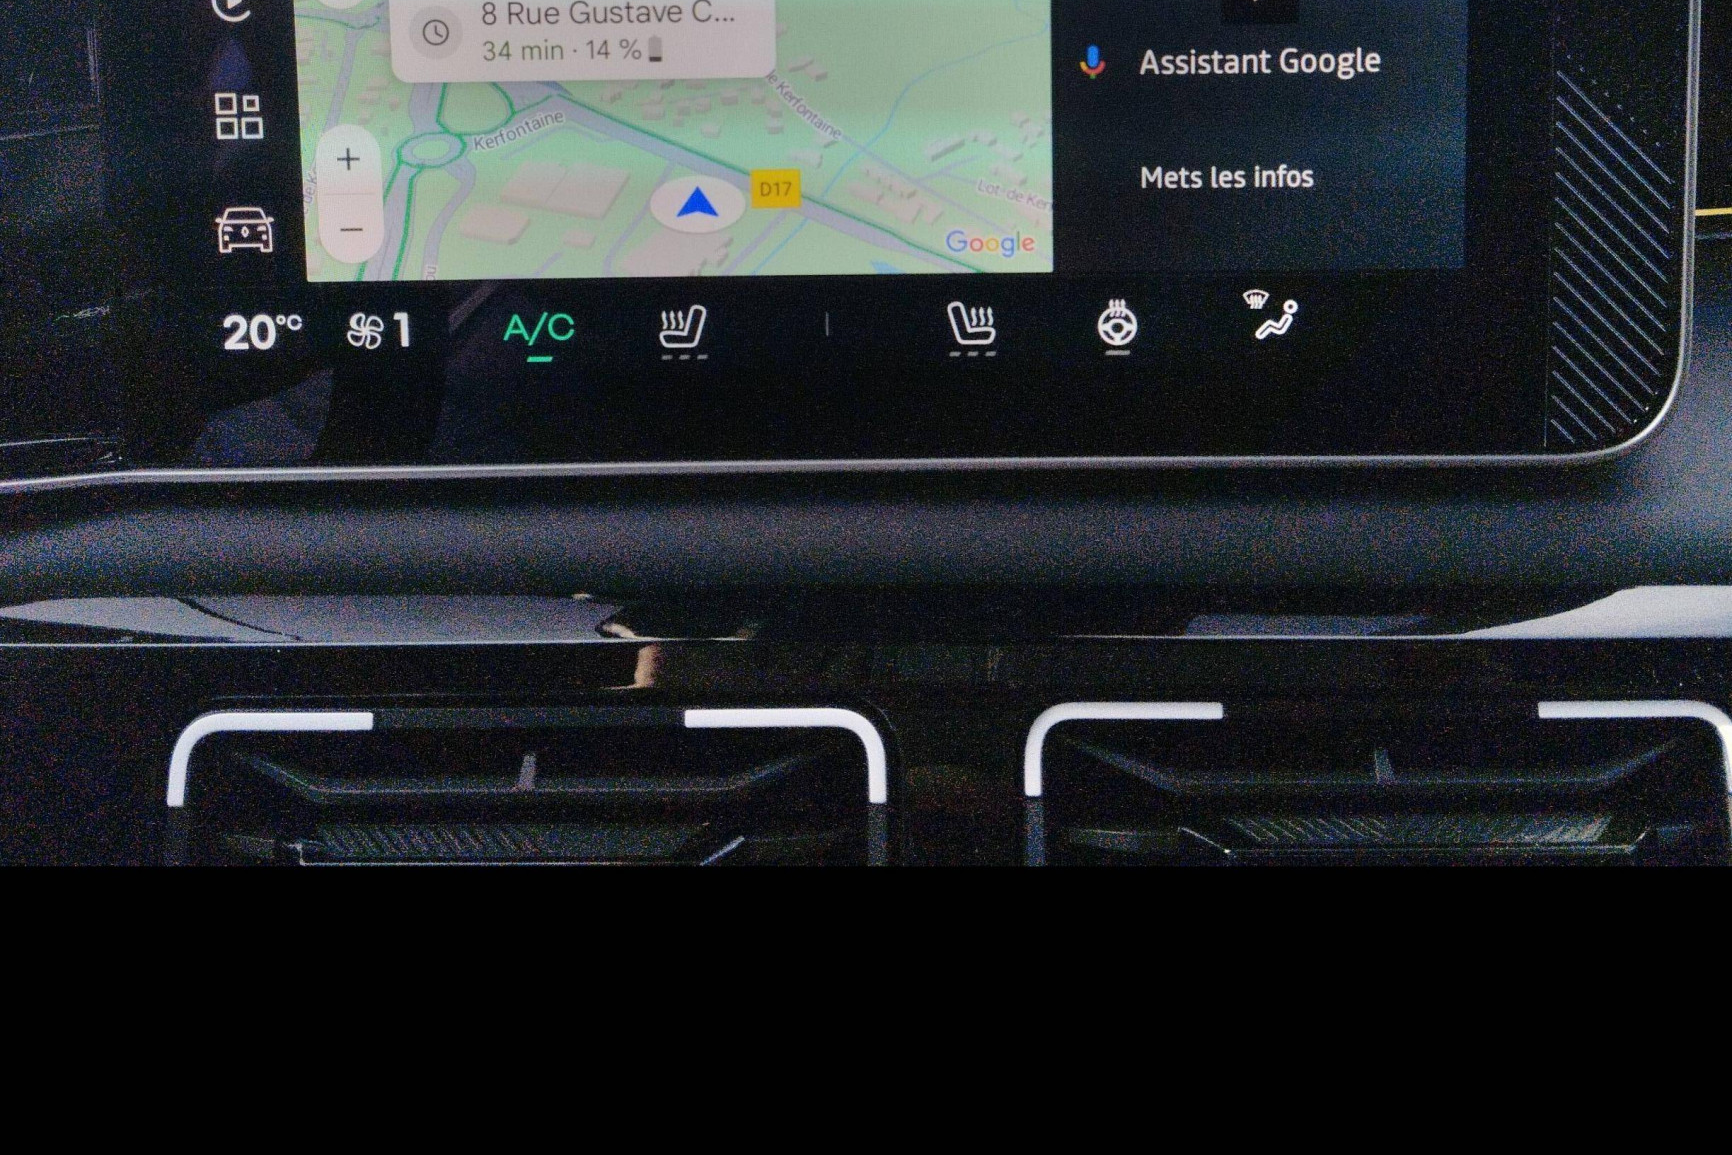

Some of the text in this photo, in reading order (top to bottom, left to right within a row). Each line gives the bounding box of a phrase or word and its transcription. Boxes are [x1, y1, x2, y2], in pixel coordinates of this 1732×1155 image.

[481, 0, 498, 26] 8
[507, 1, 561, 25] Rue
[568, 0, 683, 25] Gustave
[482, 38, 642, 62] 34 min 14 %
[1139, 46, 1382, 80] Assistant Google
[775, 80, 842, 140] Kerfontaine
[473, 111, 565, 151] Kerfontaine
[759, 181, 792, 197] D17
[1140, 163, 1315, 189] Mets les infos
[945, 229, 1036, 258] Google
[393, 311, 411, 348] 1
[503, 311, 575, 347] A/C
